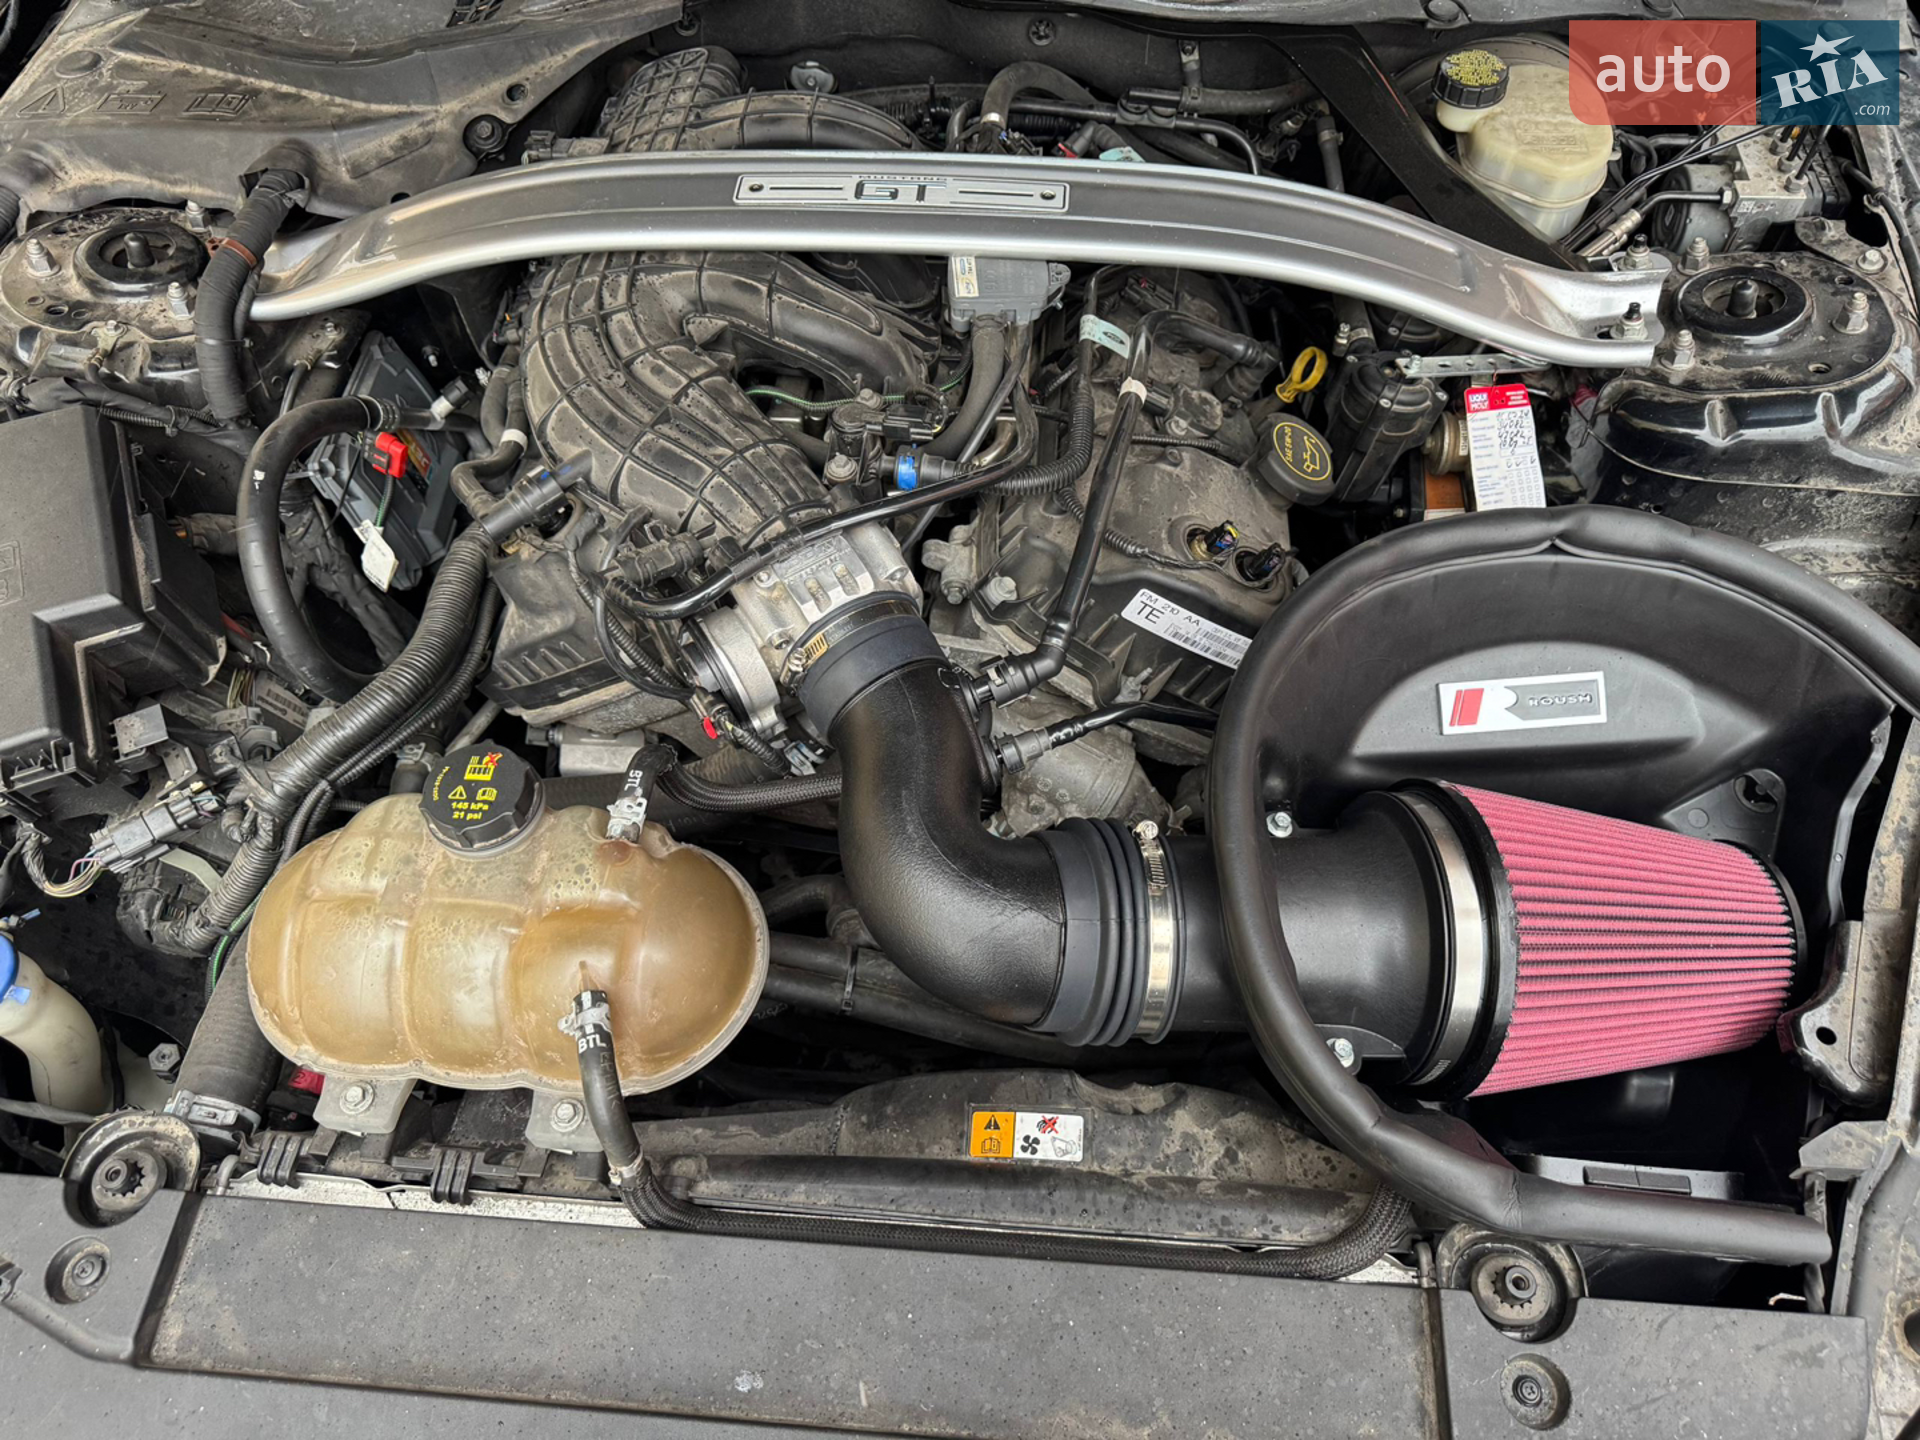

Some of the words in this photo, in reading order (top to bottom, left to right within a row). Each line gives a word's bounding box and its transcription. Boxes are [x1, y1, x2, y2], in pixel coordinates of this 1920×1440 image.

[854, 180, 947, 202] GT
[1137, 600, 1165, 625] TE
[1140, 591, 1159, 605] FM
[1183, 615, 1200, 627] AA
[1528, 692, 1593, 707] ROUSH
[452, 811, 465, 819] 21
[466, 812, 482, 820] psi
[470, 802, 488, 811] kPa
[578, 1034, 607, 1054] BTL
